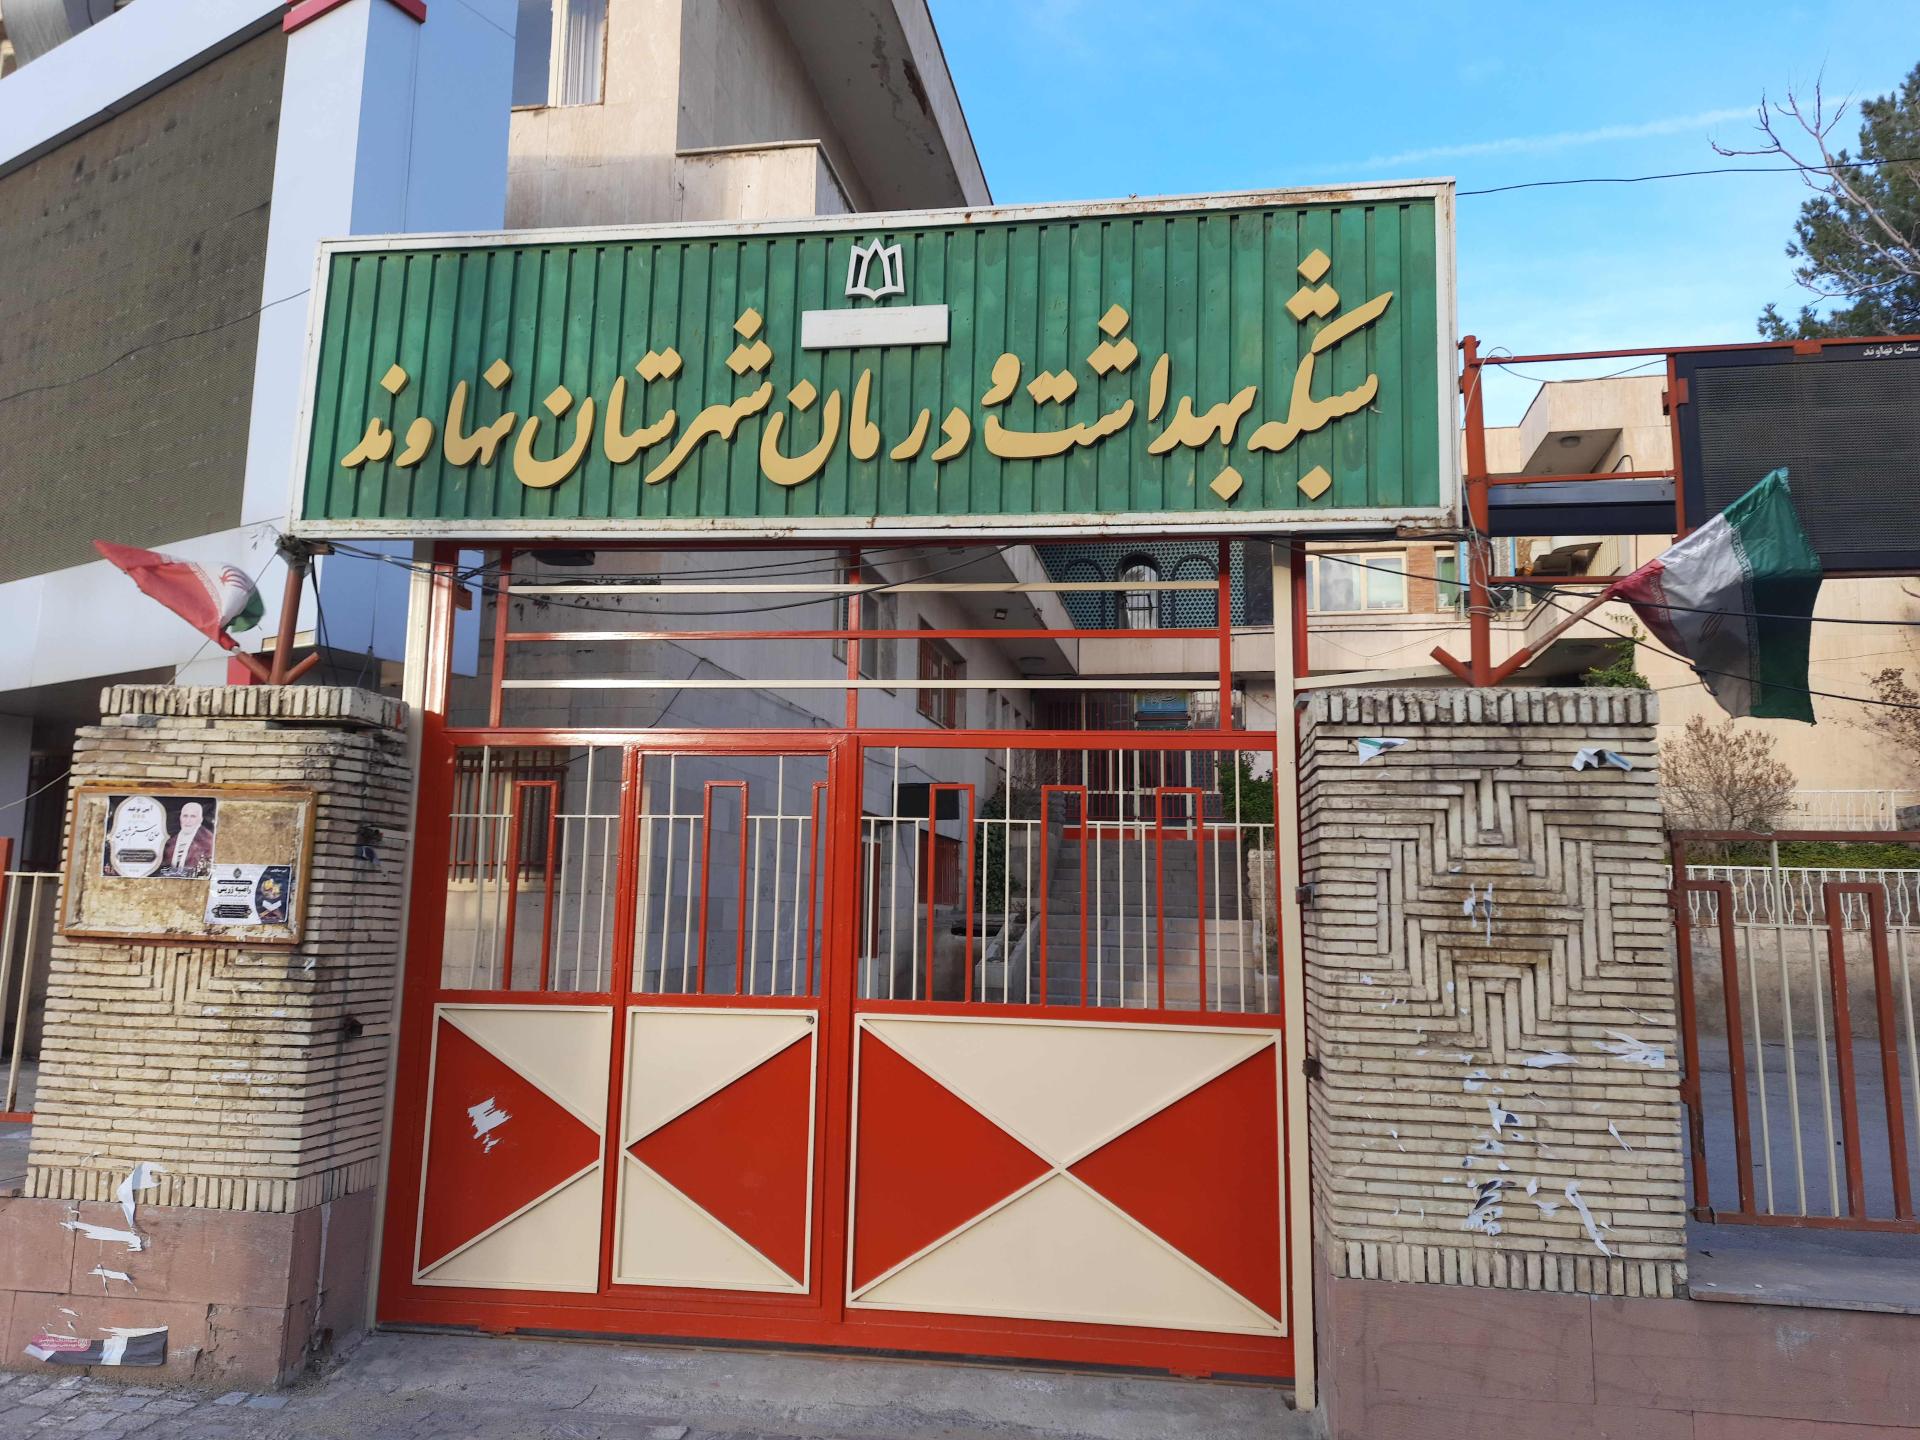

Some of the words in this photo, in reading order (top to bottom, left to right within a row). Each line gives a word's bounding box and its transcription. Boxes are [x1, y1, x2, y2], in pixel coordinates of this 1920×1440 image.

[515, 309, 772, 487] شهرستان
[982, 353, 1021, 406] و
[984, 306, 1257, 500] بهداشت
[1247, 248, 1393, 500] شبکه
[1863, 344, 1893, 358] نهاوند
[1894, 342, 1920, 355] ستان
[342, 360, 516, 467] نهاوند
[760, 370, 971, 486] درمان
